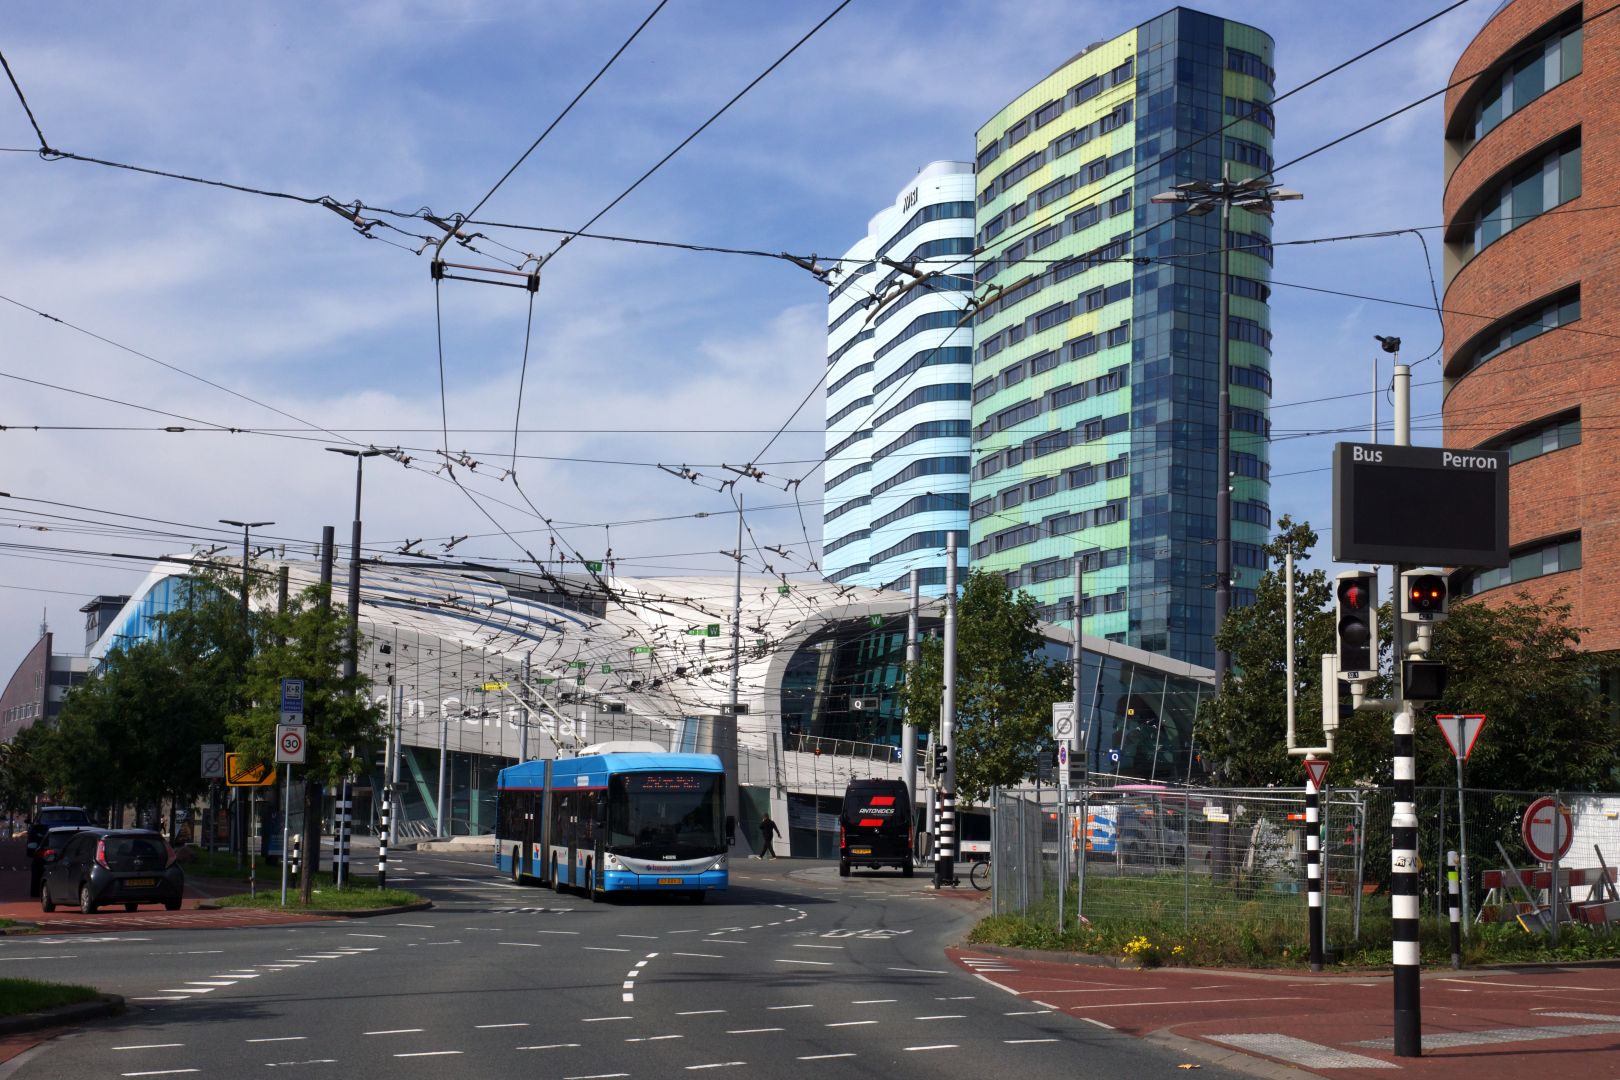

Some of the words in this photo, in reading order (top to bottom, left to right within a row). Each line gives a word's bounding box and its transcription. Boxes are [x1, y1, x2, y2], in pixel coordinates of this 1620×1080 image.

[1353, 446, 1383, 463] Bus
[1442, 451, 1498, 469] Perron
[871, 616, 881, 625] W
[602, 704, 608, 712] S
[854, 700, 862, 710] Q
[724, 706, 730, 714] K
[285, 739, 298, 749] 30
[1111, 753, 1119, 762] Q
